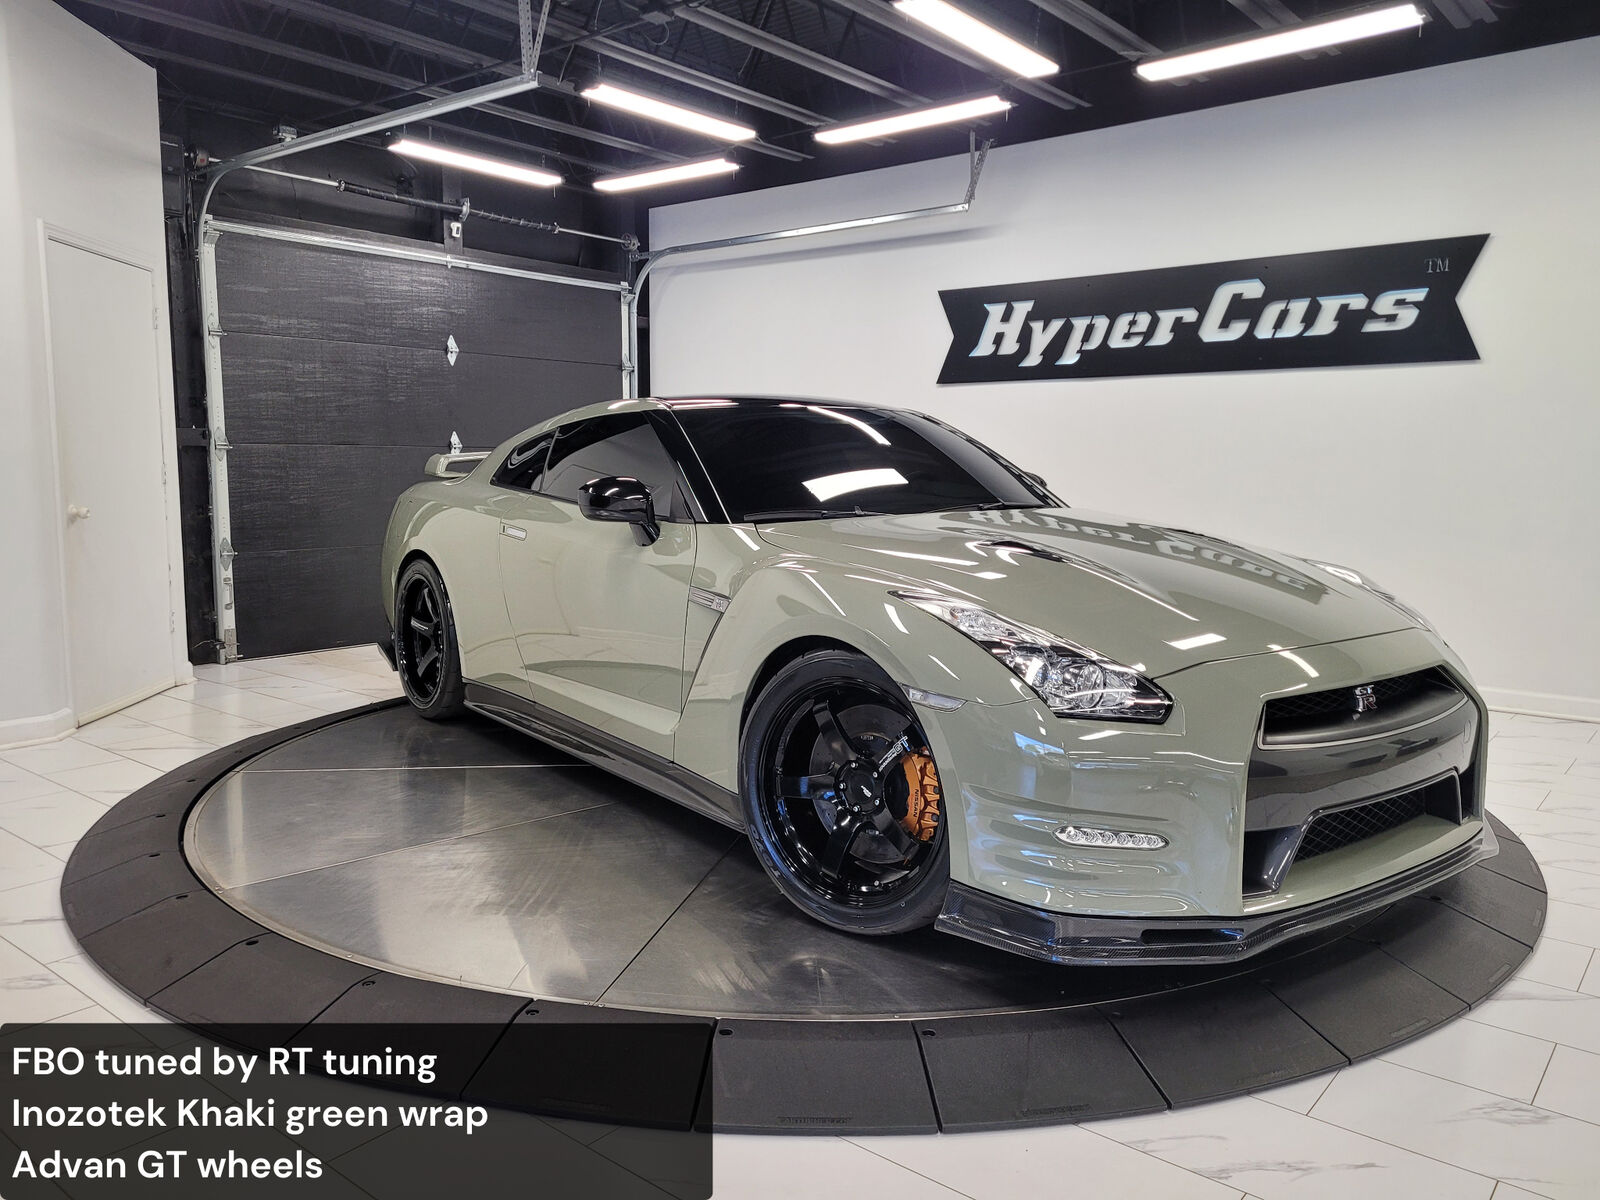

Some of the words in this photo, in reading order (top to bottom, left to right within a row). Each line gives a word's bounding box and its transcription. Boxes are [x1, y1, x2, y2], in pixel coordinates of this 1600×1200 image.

[968, 277, 1430, 368] HyperCars
[1424, 257, 1449, 273] TM
[912, 788, 920, 818] NISSAN
